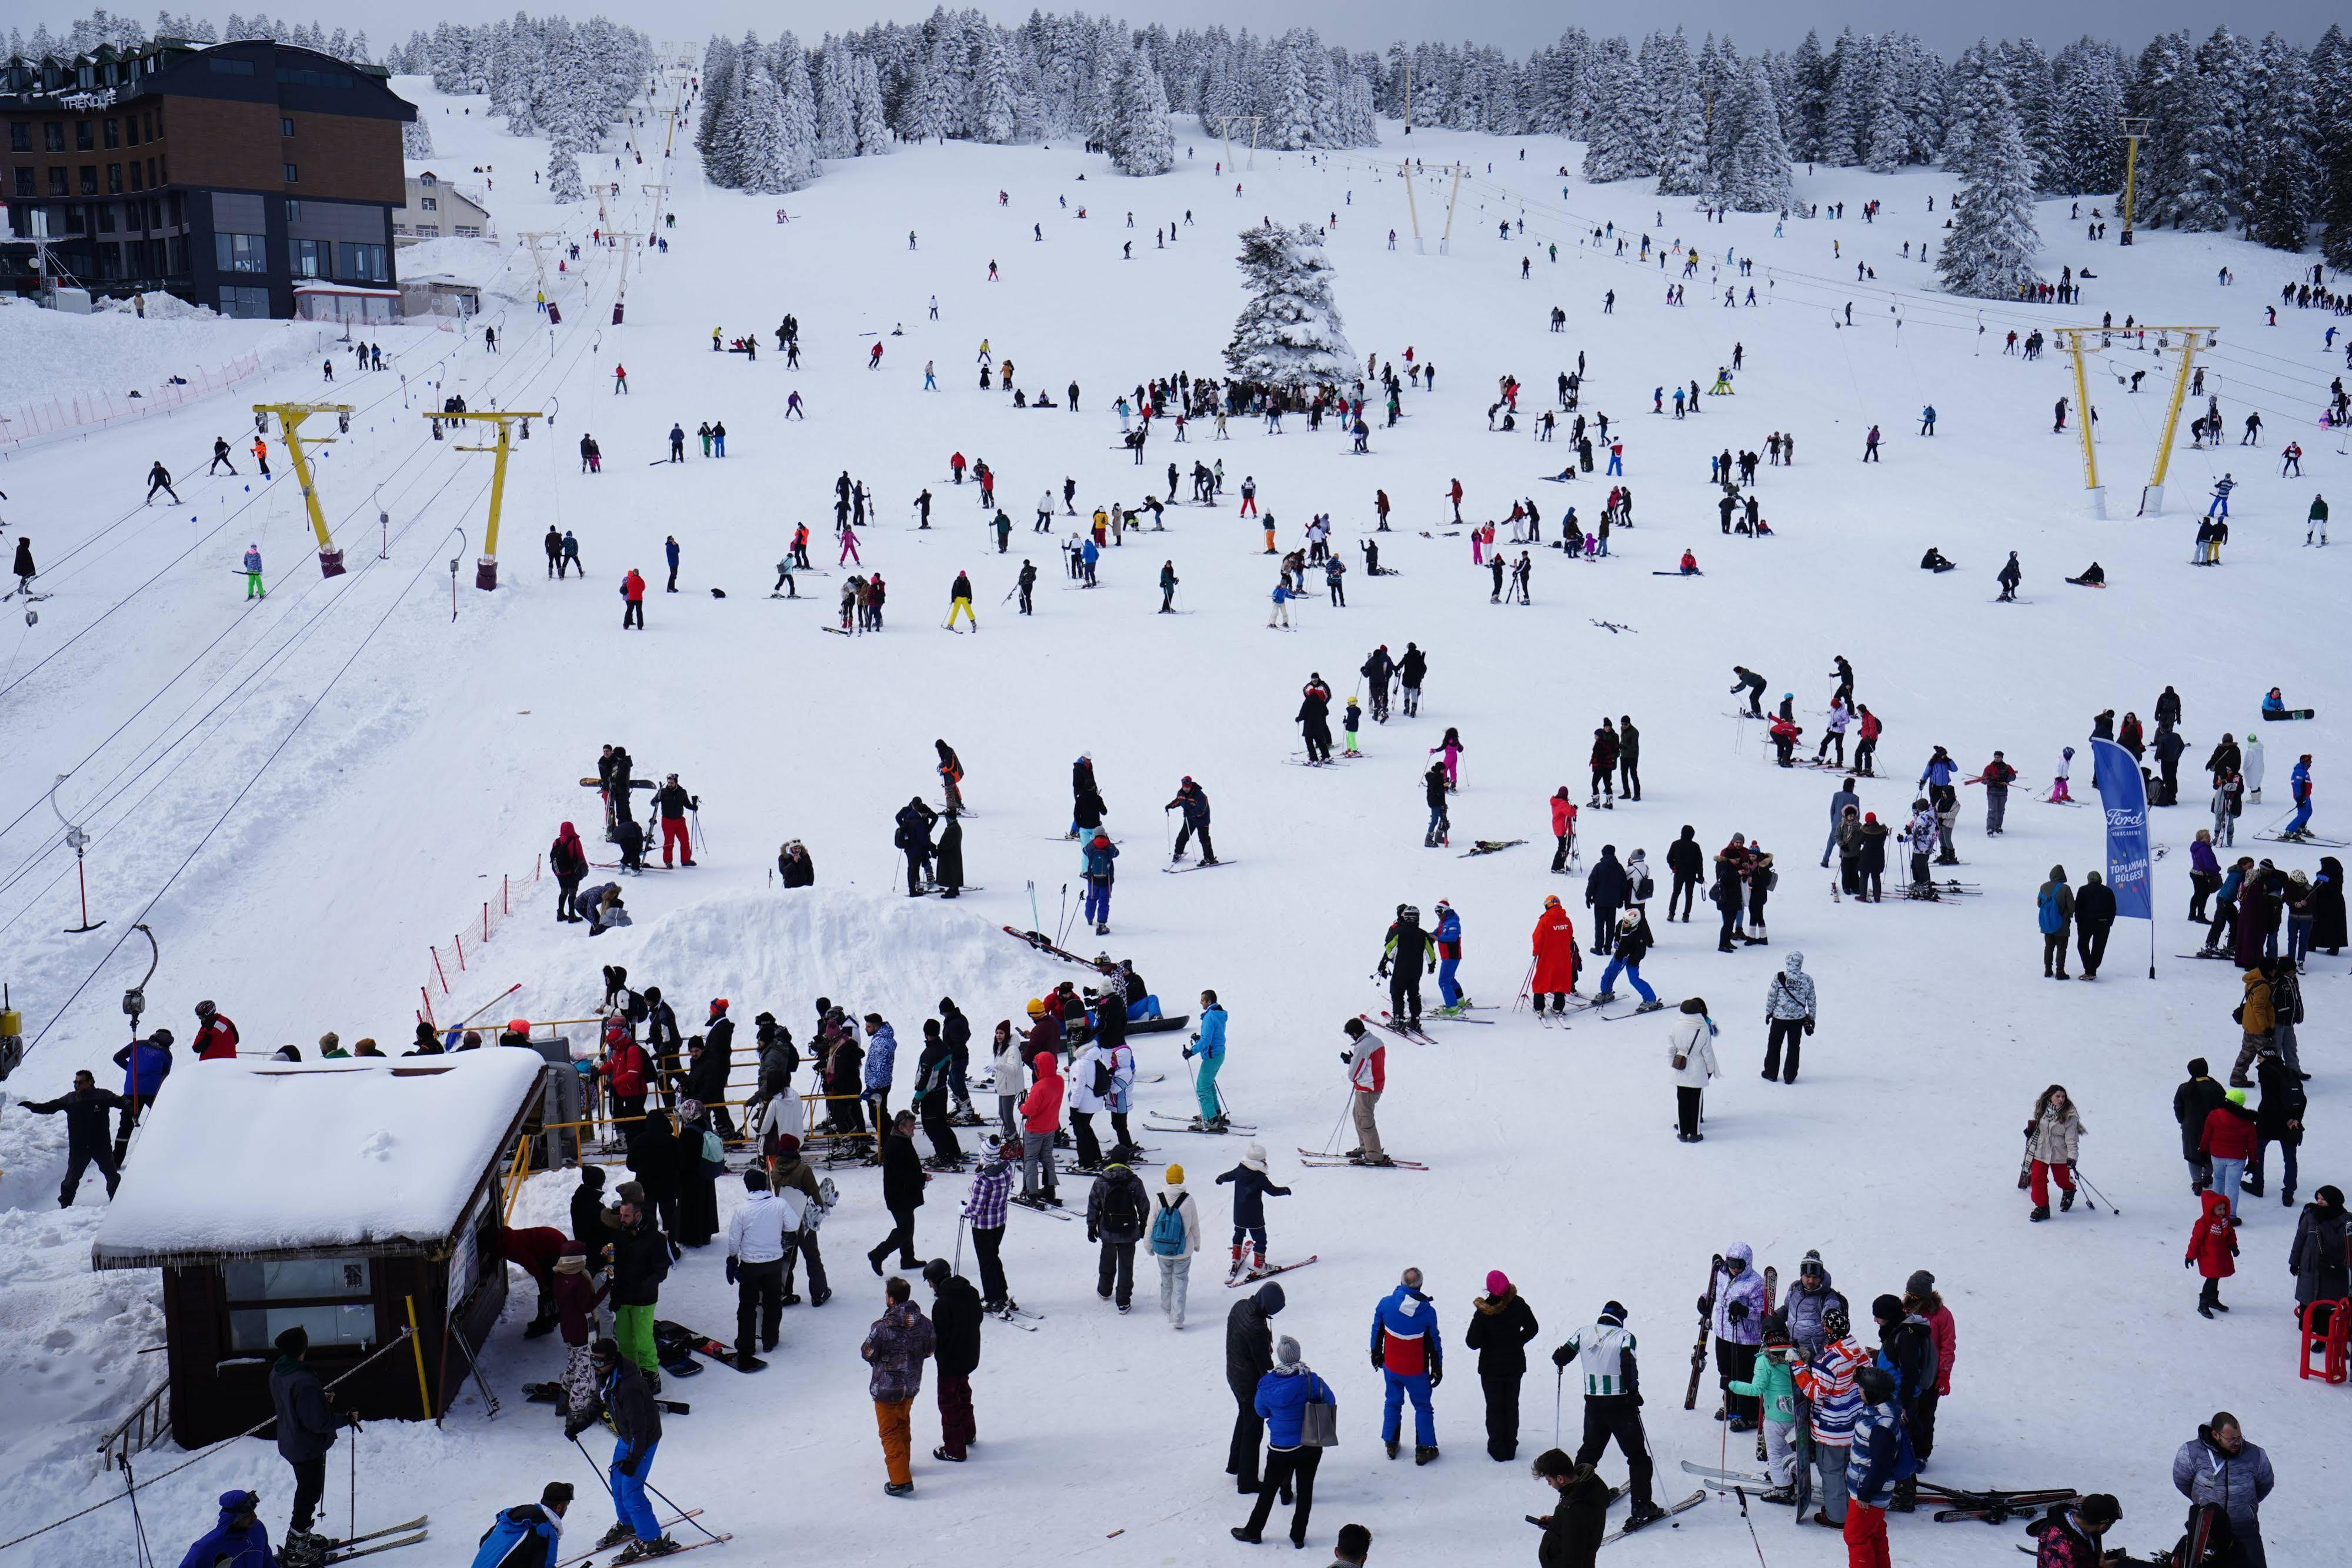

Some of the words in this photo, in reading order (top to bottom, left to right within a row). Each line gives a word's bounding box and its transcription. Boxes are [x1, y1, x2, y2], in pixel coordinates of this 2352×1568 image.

[499, 431, 506, 444] 1
[2107, 808, 2143, 826] Ford
[2110, 858, 2147, 875] TOPLANMA
[1768, 1270, 1776, 1316] FISCHER
